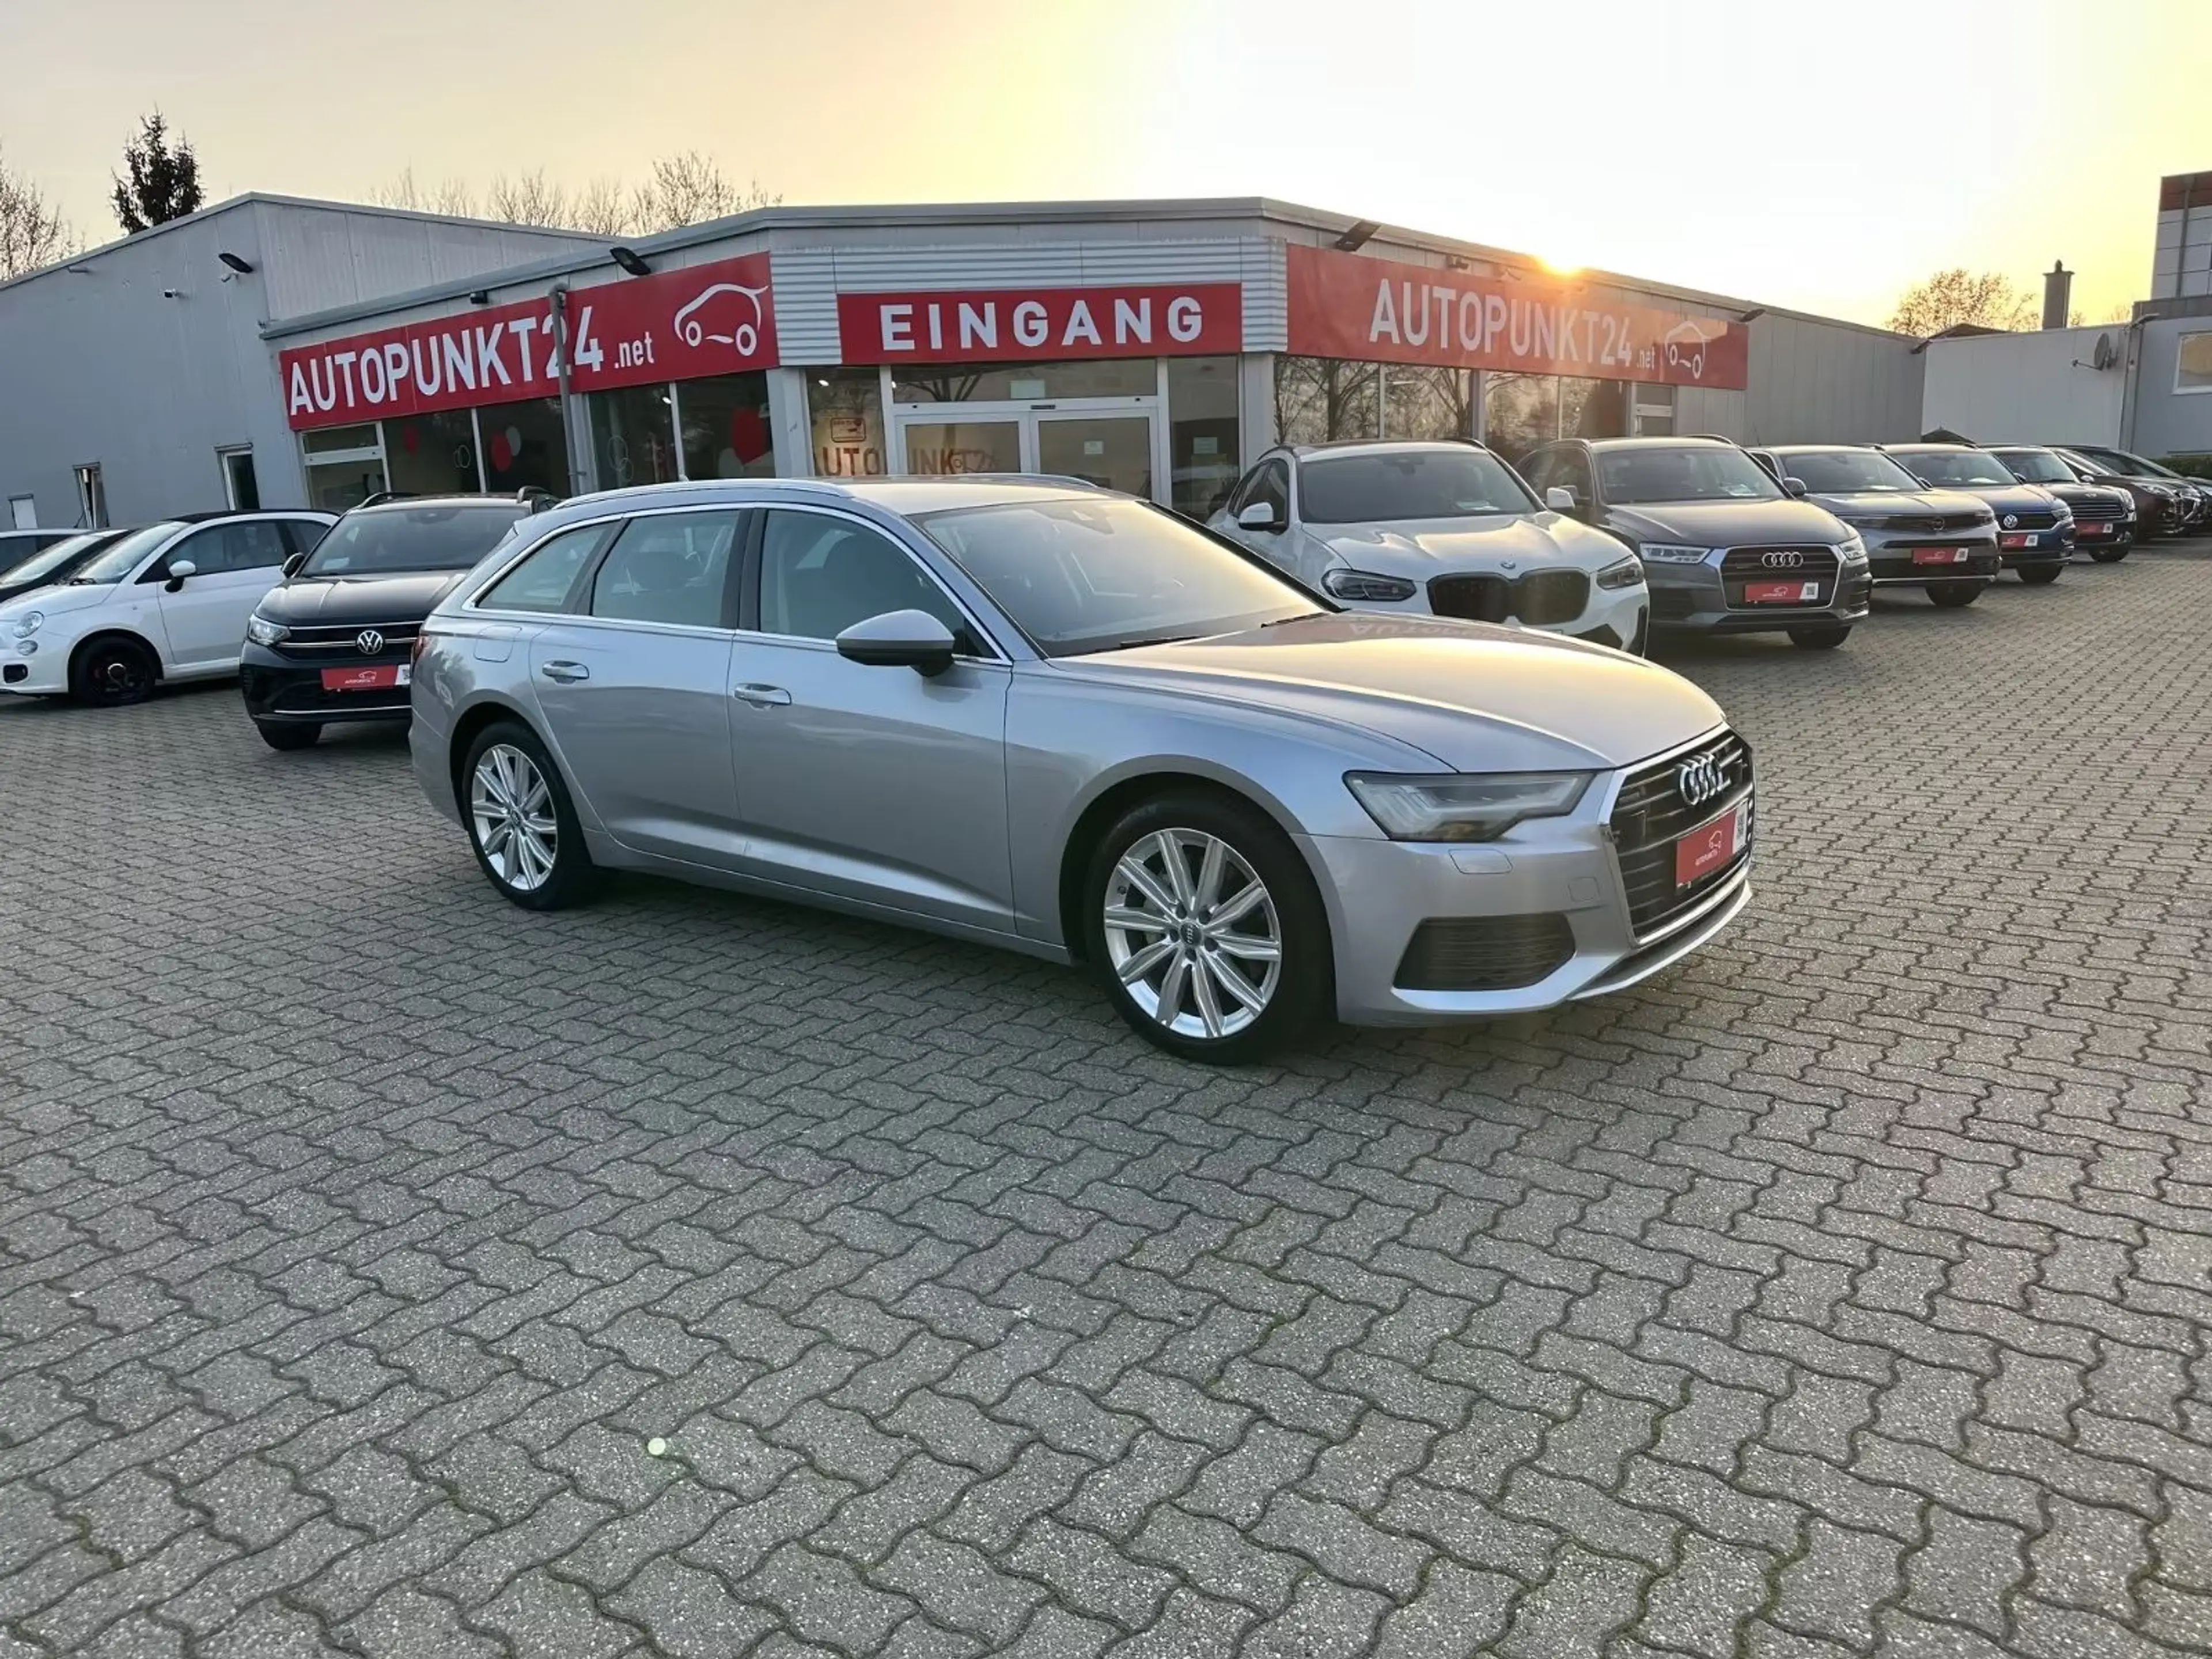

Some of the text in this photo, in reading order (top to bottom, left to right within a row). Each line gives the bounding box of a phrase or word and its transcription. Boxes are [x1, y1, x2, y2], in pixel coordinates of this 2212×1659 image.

[290, 305, 655, 416] AUTOPUNKT24 .net
[879, 297, 1203, 351] EINGANG
[1369, 278, 1655, 370] AUTOPUNKT24 .net
